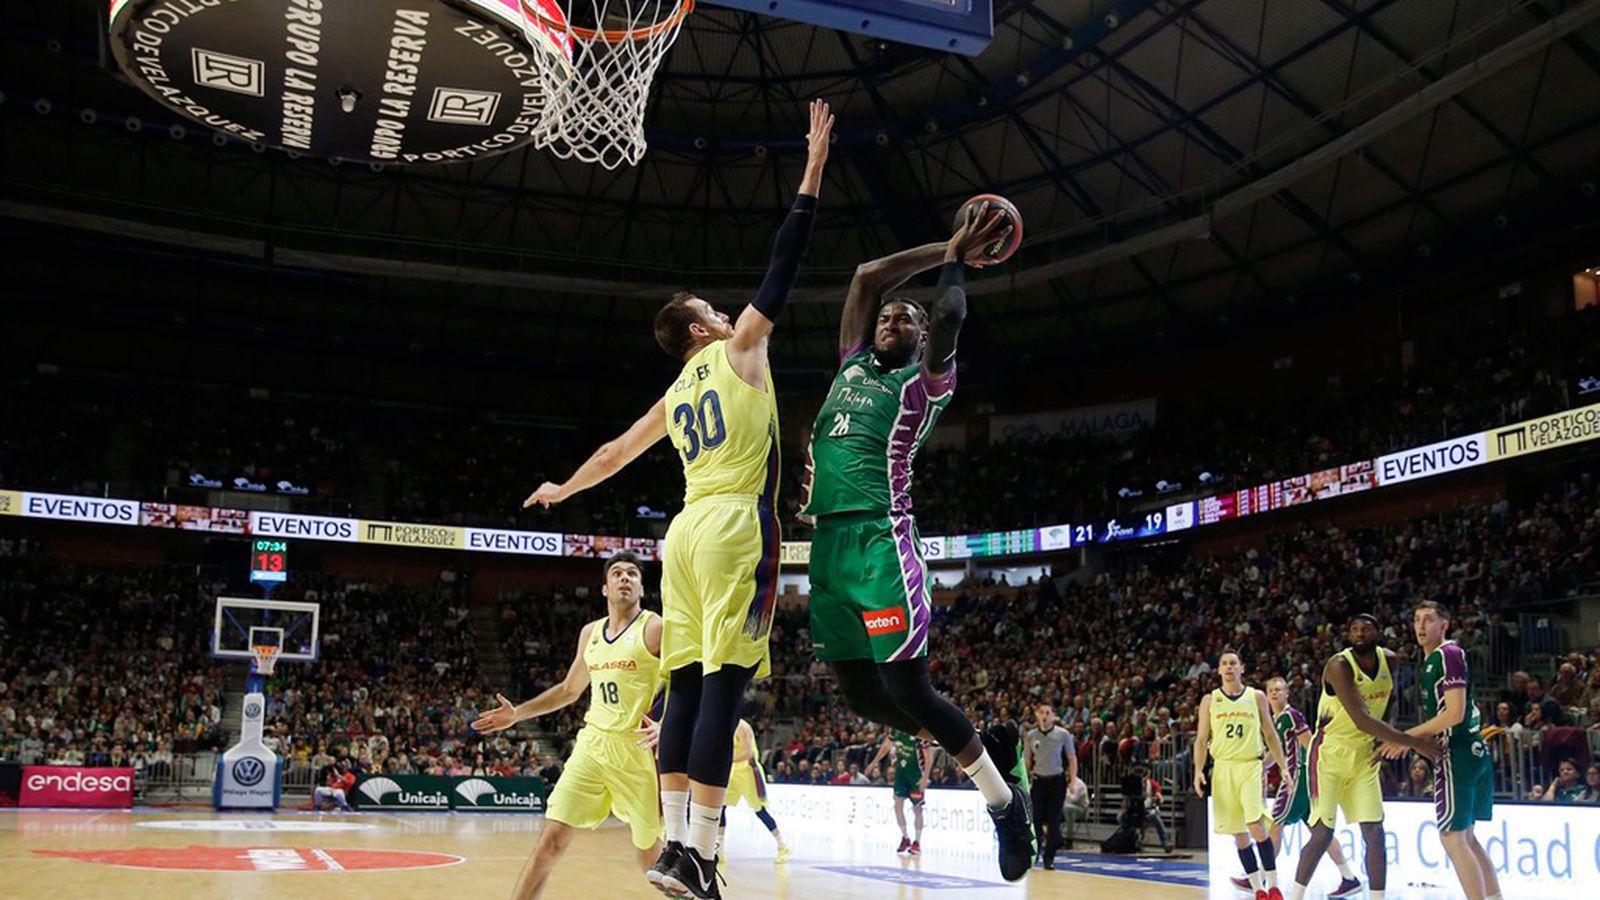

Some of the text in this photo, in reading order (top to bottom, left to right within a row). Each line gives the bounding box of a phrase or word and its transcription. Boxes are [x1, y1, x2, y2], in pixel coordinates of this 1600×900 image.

[370, 9, 430, 159] GRUPO LA RESERVA
[402, 132, 516, 163] PORTICO
[673, 389, 727, 463] 30
[828, 411, 851, 437] 26
[1530, 409, 1596, 436] PORTICO
[1383, 440, 1480, 481] EVENTOS
[29, 497, 133, 521] EVENTOS
[257, 516, 352, 539] EVENTOS
[395, 525, 448, 537] PORTICO
[1145, 512, 1163, 531] 19
[396, 533, 456, 546] VELAZQUEZ
[470, 532, 557, 552] EVENTOS
[1075, 524, 1093, 543] 21
[258, 553, 283, 572] 13
[599, 681, 620, 705] 18
[1226, 724, 1244, 739] 24
[27, 772, 131, 792] endesa
[398, 790, 448, 806] Unicaja
[493, 792, 542, 807] Unicaja
